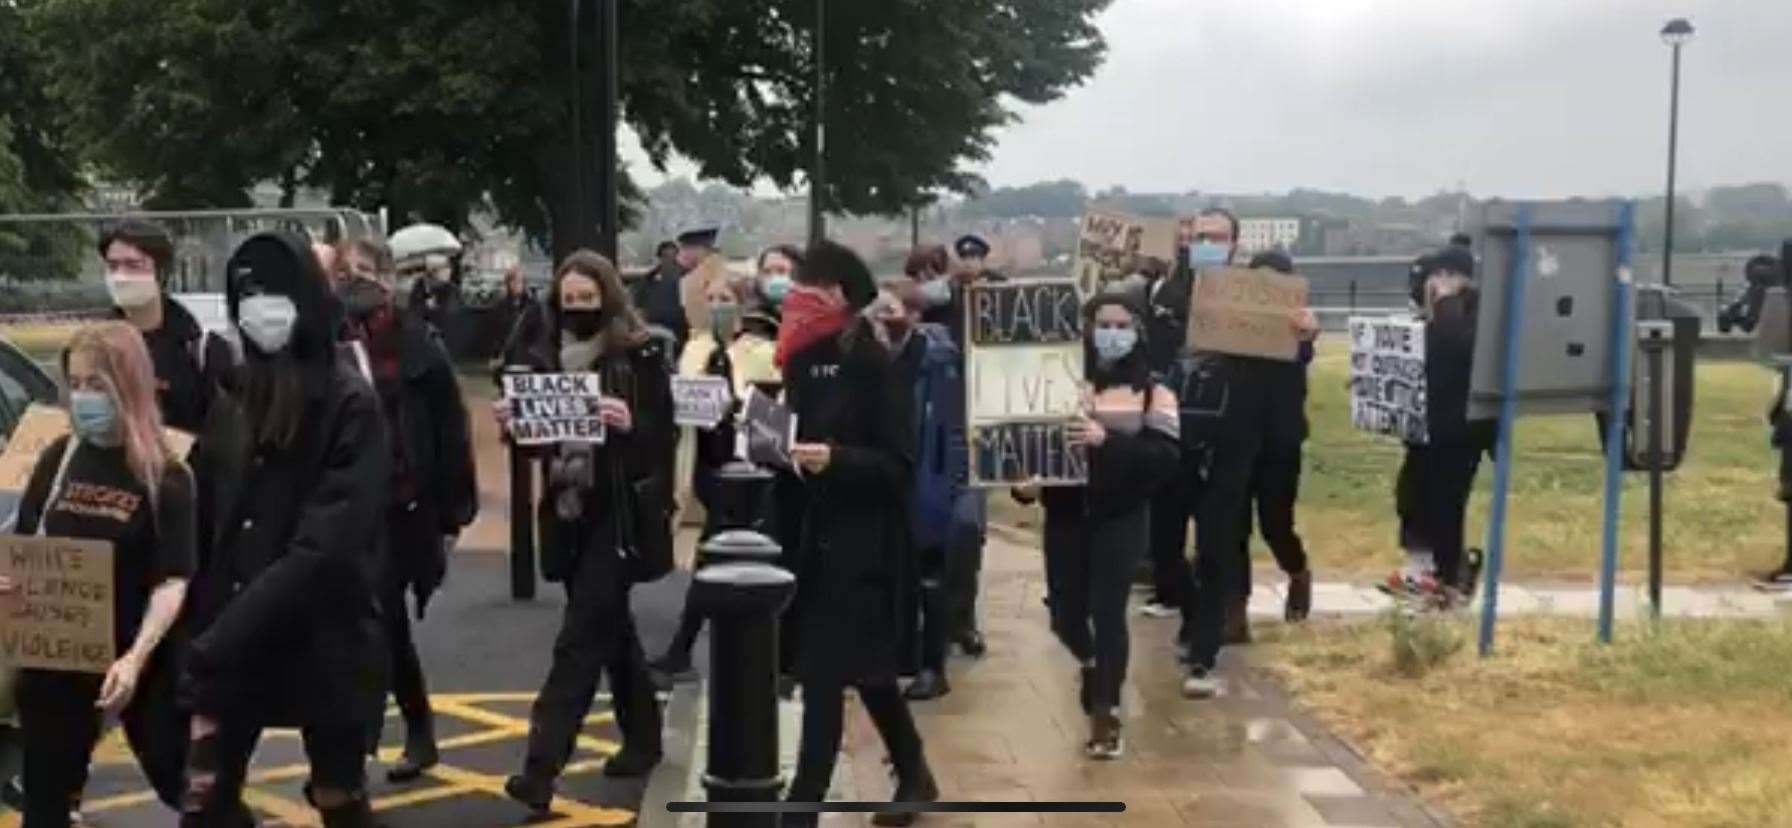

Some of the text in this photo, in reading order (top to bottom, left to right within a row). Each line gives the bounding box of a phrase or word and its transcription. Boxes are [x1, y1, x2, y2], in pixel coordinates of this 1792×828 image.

[974, 286, 1078, 342] BLACK
[513, 376, 589, 394] BLACK
[511, 398, 599, 417] LIVES
[514, 419, 602, 438] MATTER
[976, 425, 1087, 482] MATTER
